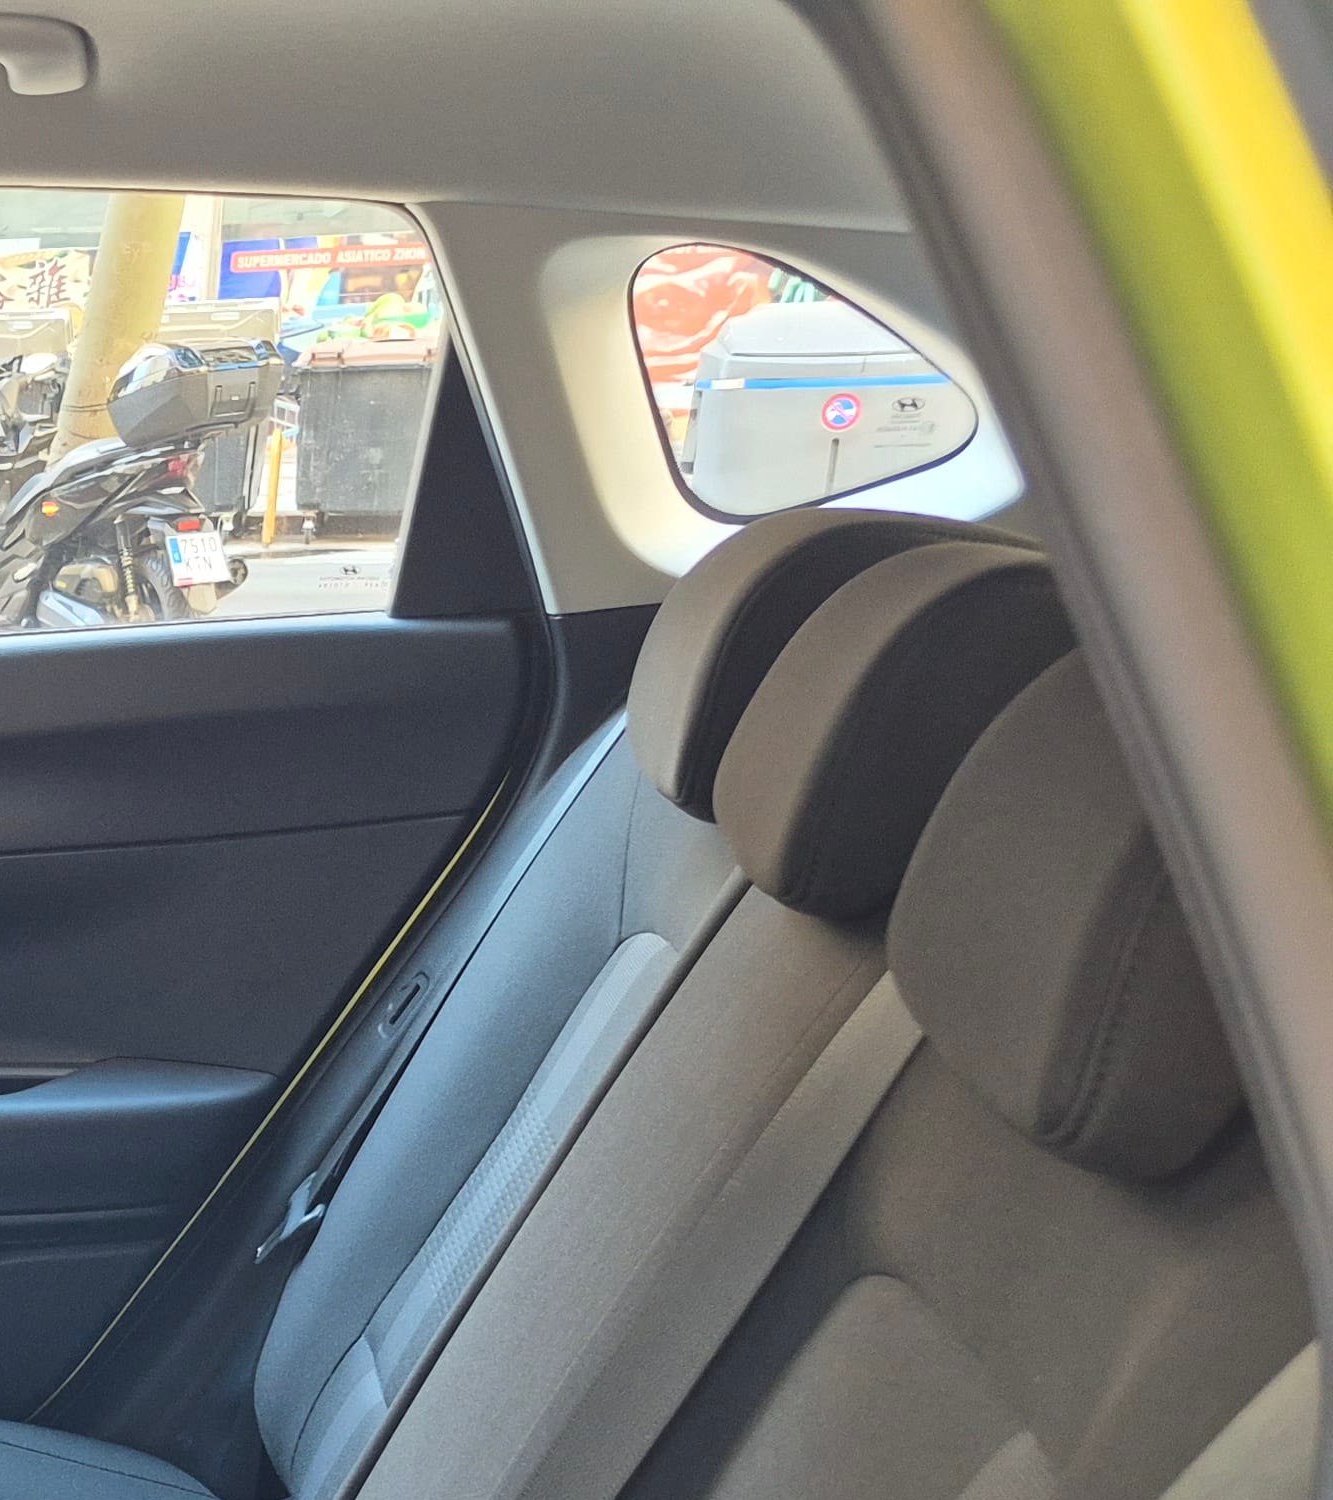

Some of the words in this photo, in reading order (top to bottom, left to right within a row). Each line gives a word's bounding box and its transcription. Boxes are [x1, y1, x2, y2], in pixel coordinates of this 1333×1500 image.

[237, 251, 331, 268] SUPERMERCADO
[336, 248, 391, 264] ASIATICO
[180, 536, 217, 554] 7510
[184, 555, 212, 571] KTN
